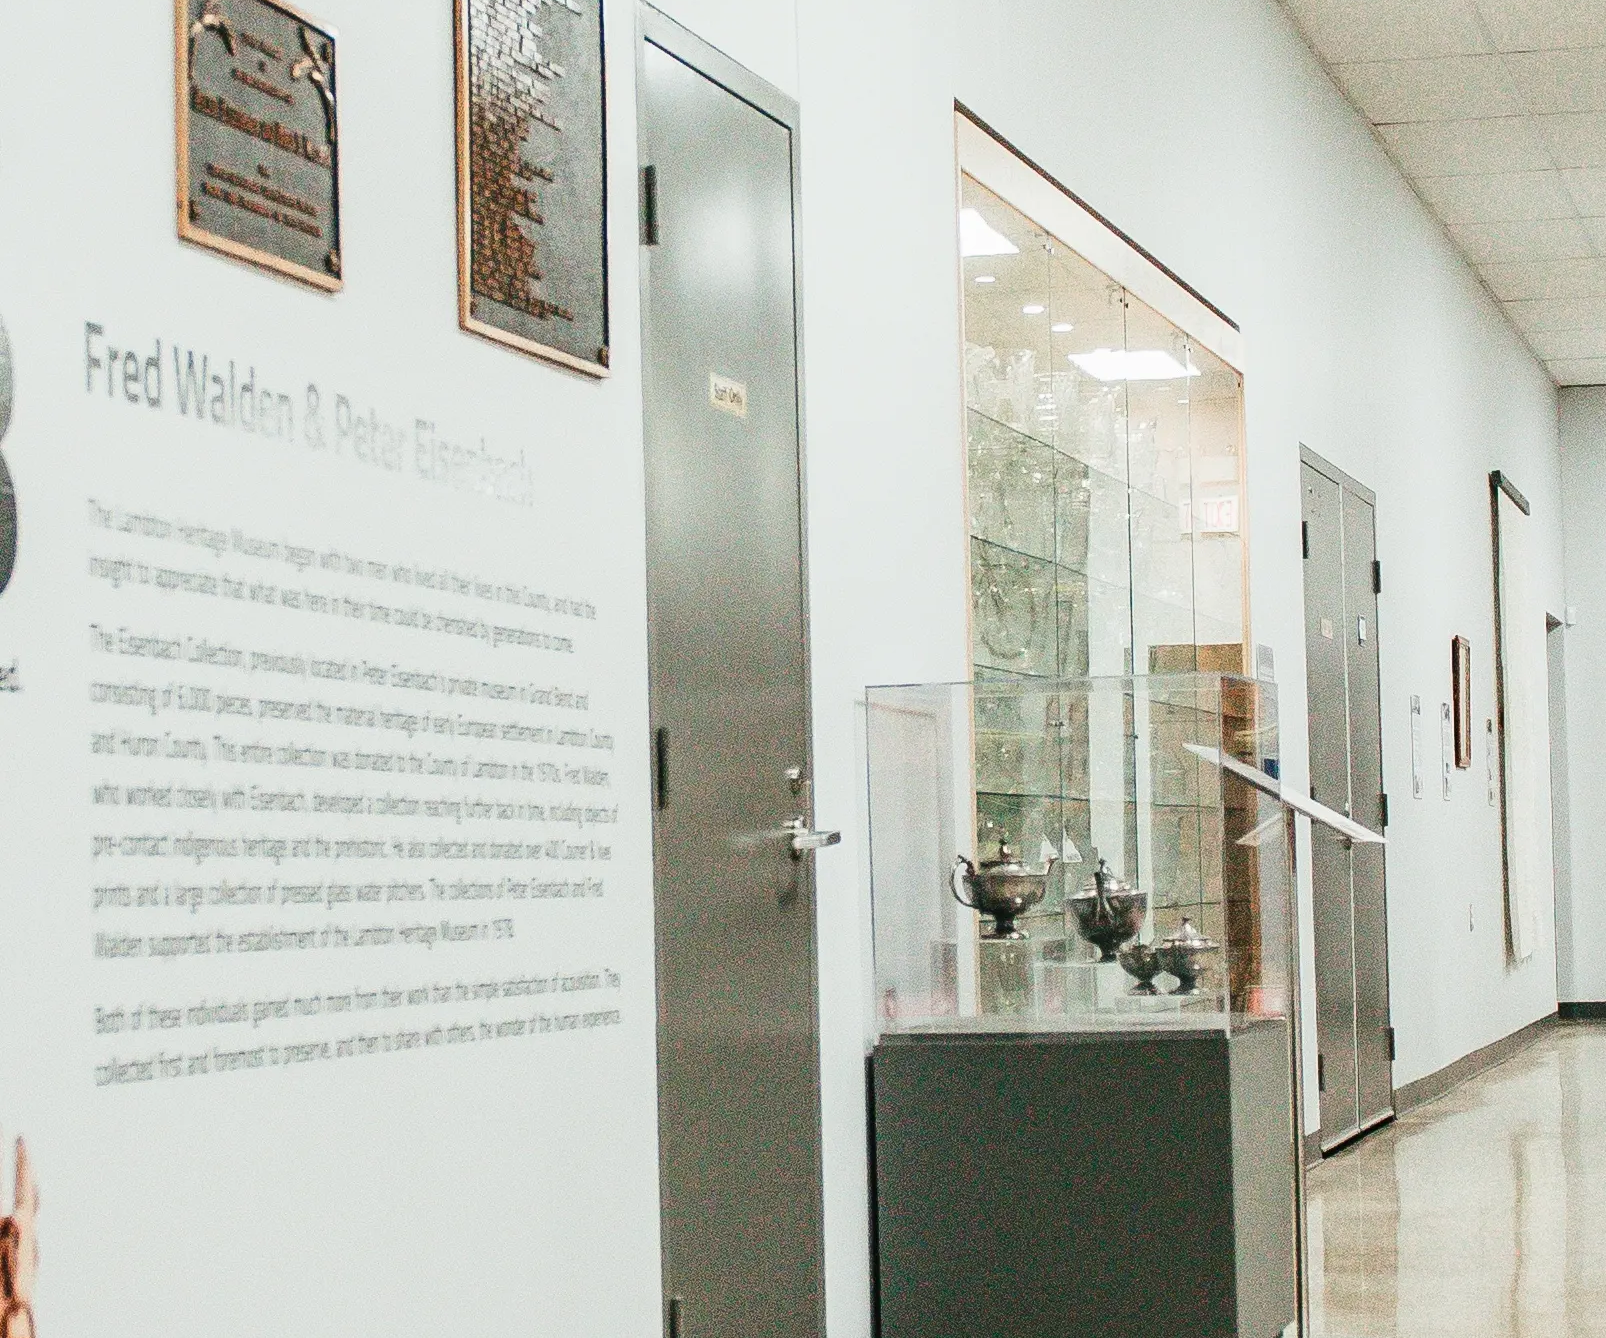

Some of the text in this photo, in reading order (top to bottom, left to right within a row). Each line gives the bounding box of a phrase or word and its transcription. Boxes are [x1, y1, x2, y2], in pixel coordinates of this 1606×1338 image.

[84, 322, 161, 406] Fred
[171, 342, 294, 445] Walden
[304, 383, 328, 451] &
[335, 394, 406, 473] Peter
